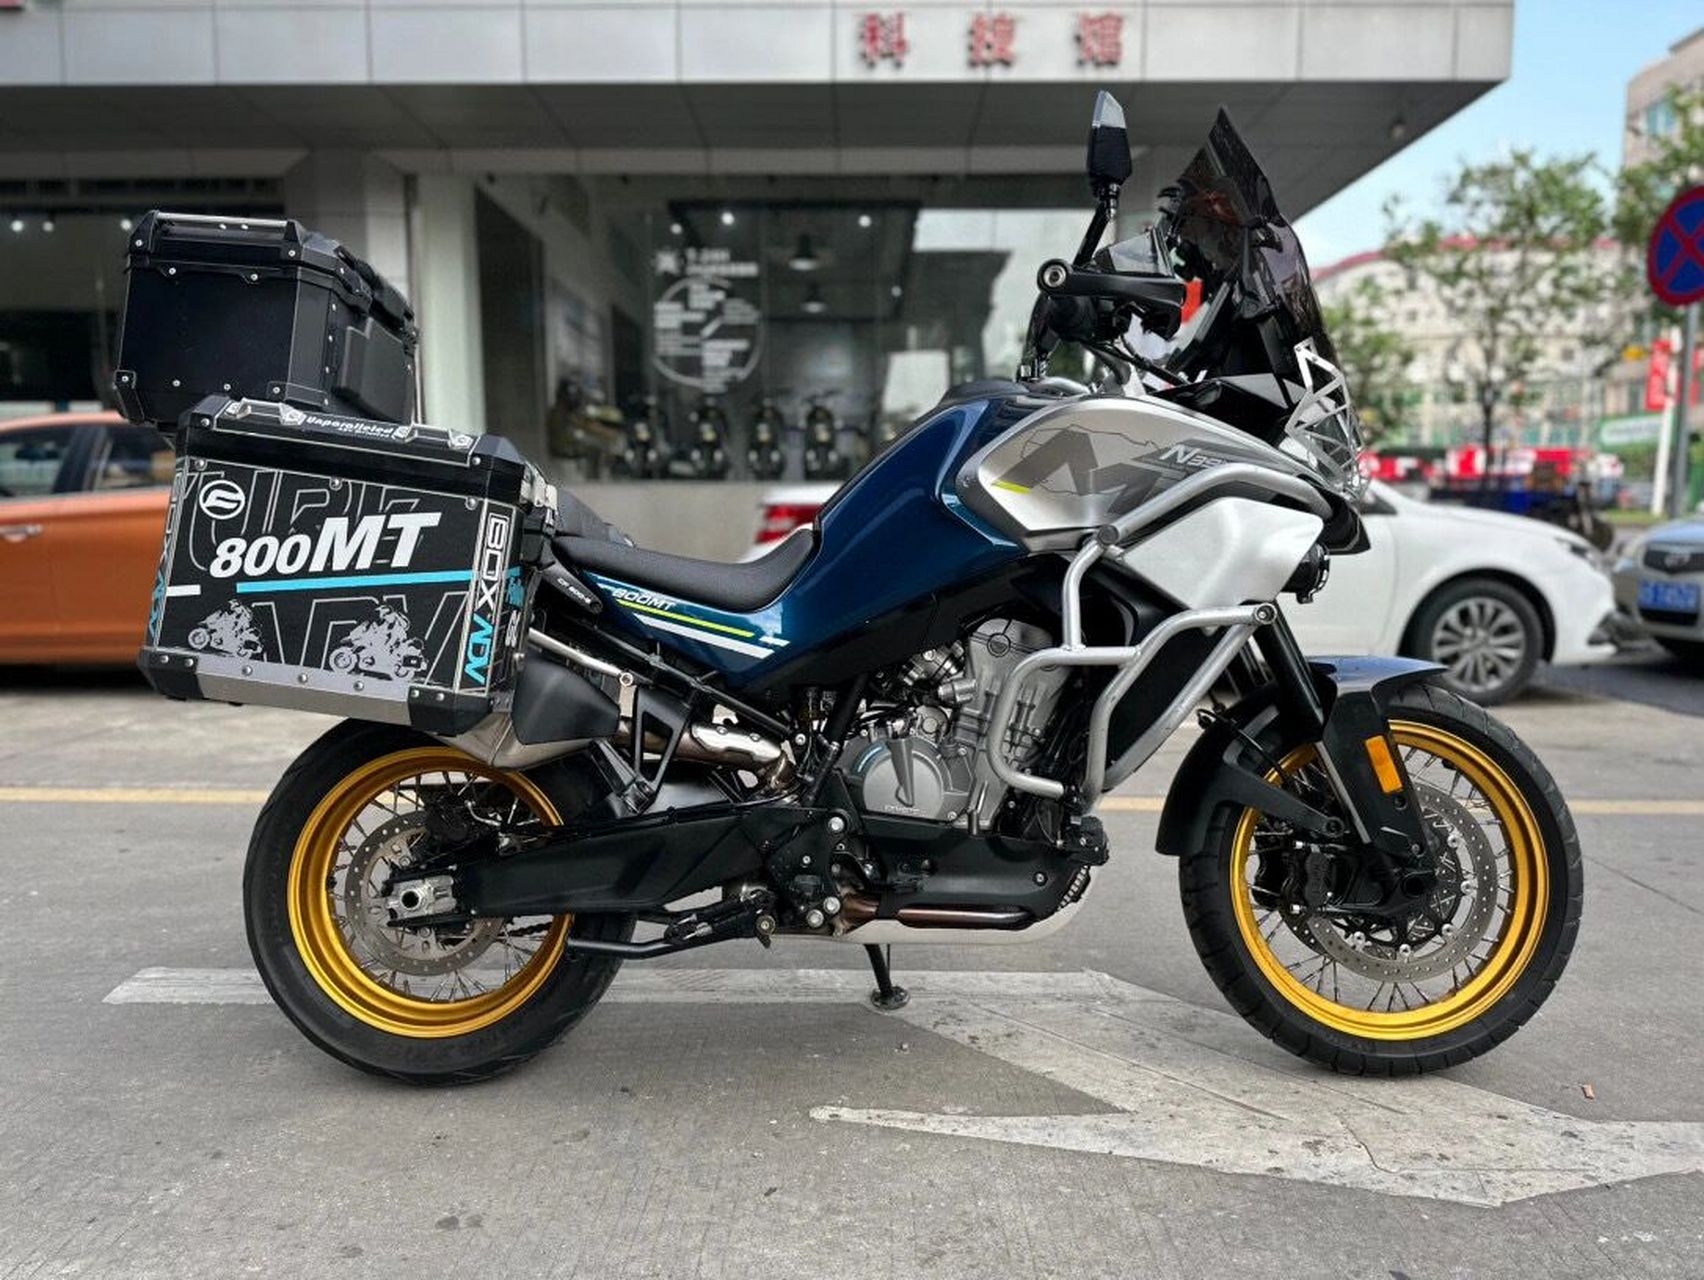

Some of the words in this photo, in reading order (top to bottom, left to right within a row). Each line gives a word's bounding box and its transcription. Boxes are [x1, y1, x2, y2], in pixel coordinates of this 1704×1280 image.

[209, 512, 442, 578] 800MT
[476, 513, 509, 611] BOX
[612, 587, 677, 610] 800MT
[464, 612, 494, 685] ADV
